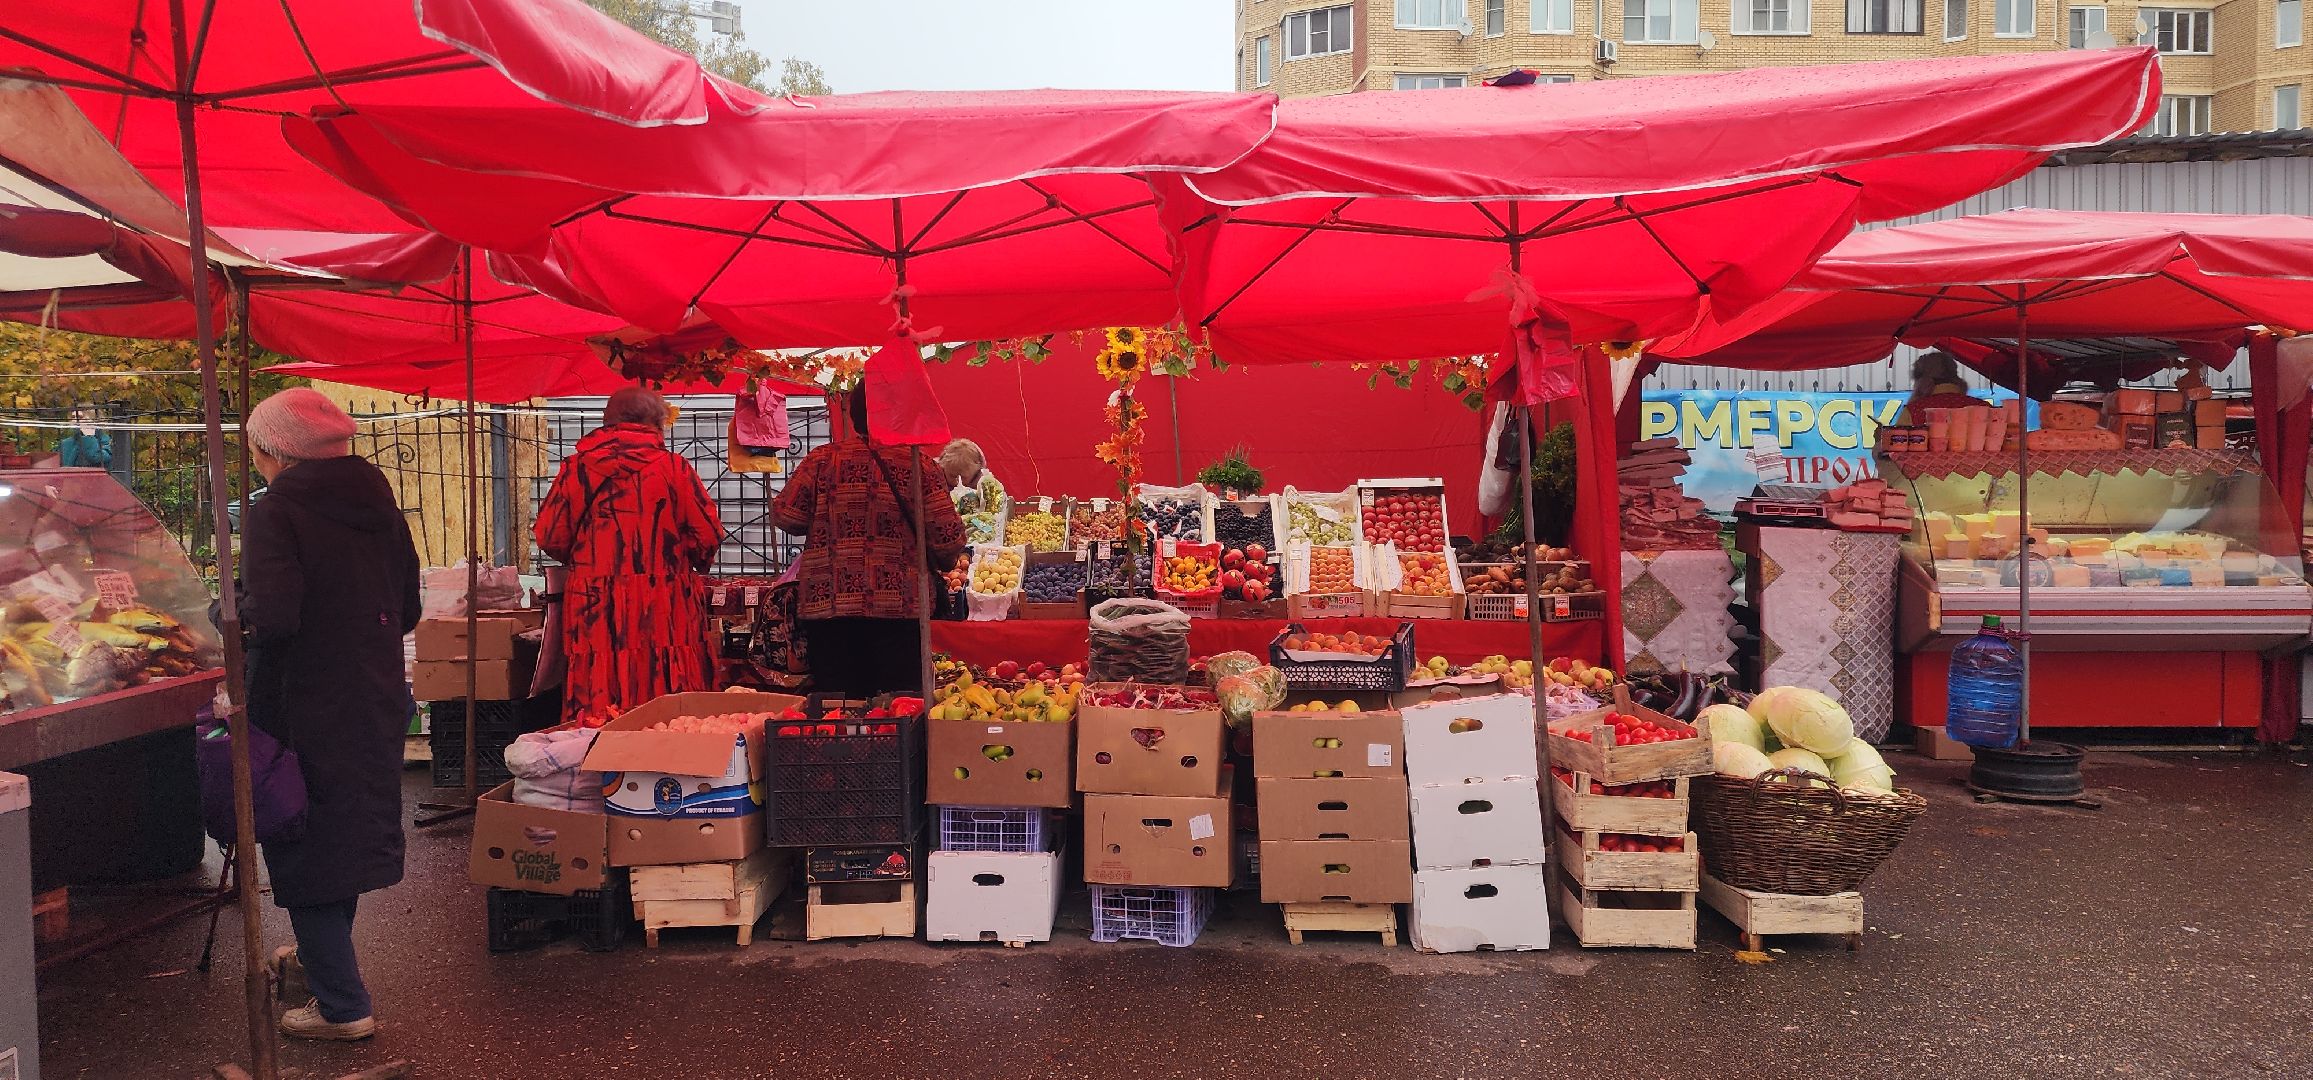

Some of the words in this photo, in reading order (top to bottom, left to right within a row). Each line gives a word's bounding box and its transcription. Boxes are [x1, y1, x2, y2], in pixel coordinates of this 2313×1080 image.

[1641, 399, 1904, 449] РМЕРСК
[1784, 456, 1878, 486] ПРОД
[512, 848, 555, 864] Global
[515, 863, 561, 884] Village
